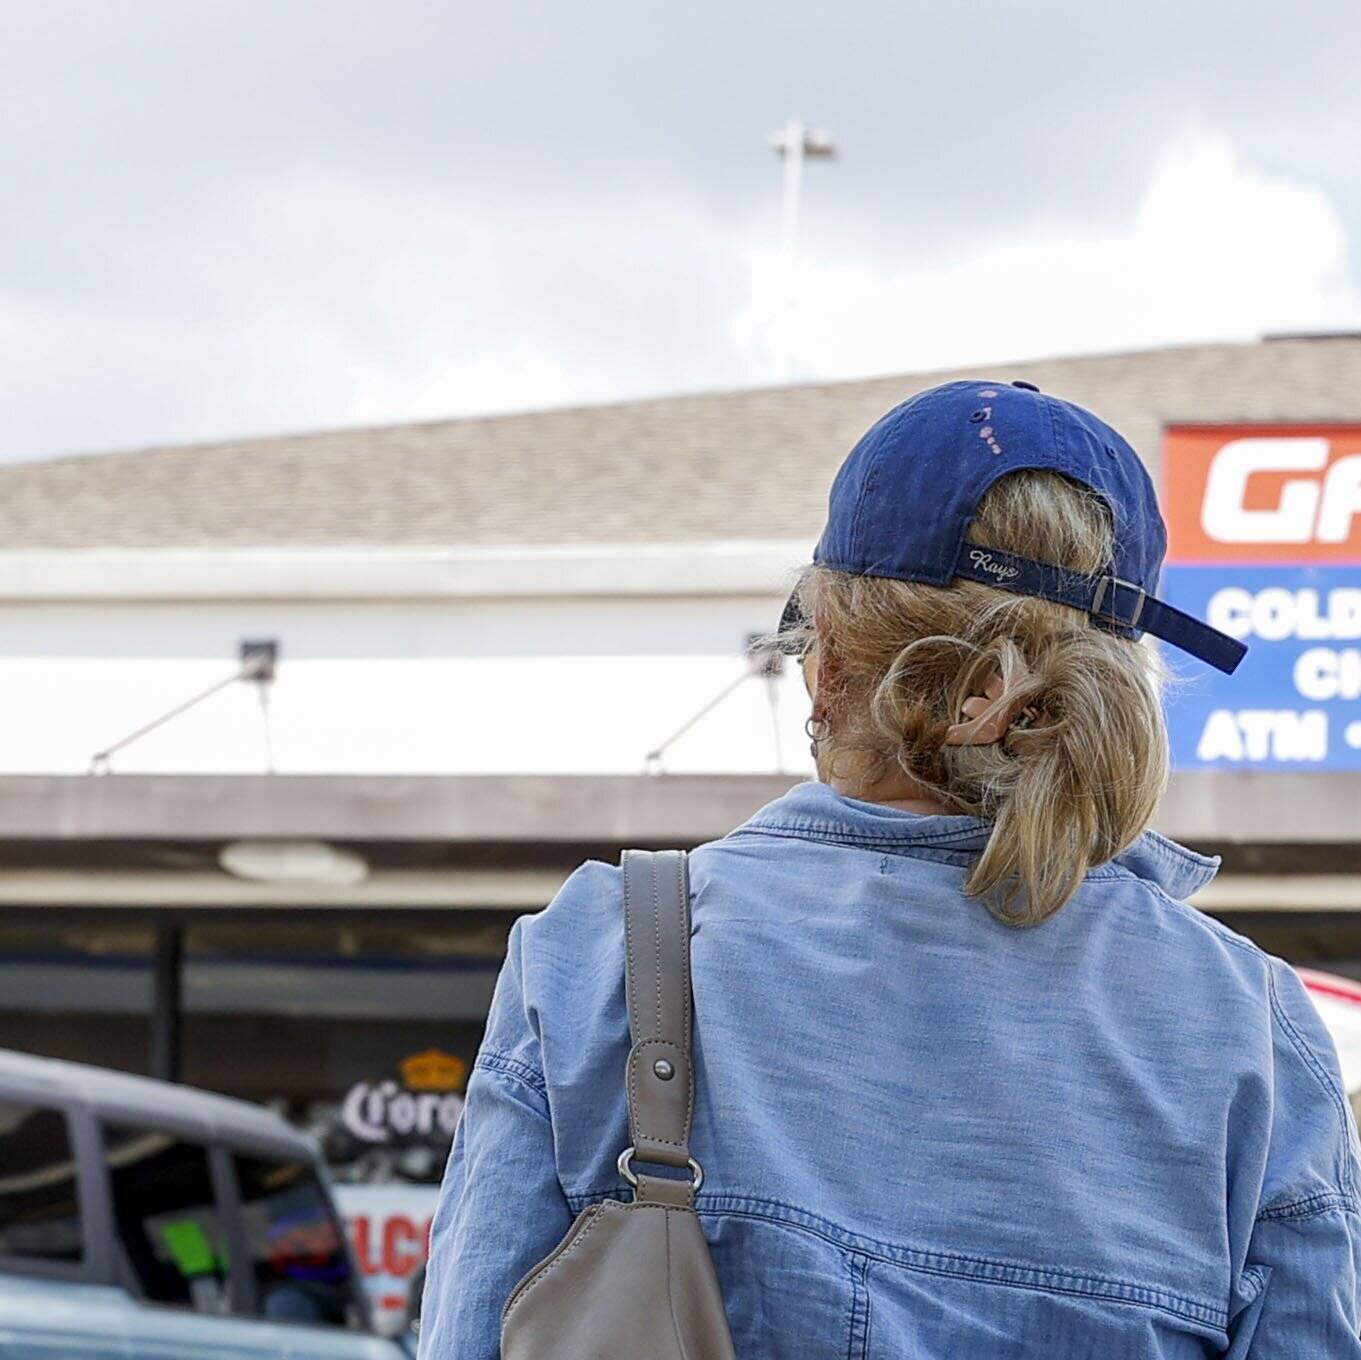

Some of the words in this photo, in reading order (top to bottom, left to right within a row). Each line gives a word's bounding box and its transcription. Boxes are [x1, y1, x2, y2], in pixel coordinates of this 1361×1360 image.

[969, 549, 1020, 583] Rays
[1196, 708, 1330, 763] ATM
[342, 1080, 465, 1142] Coro
